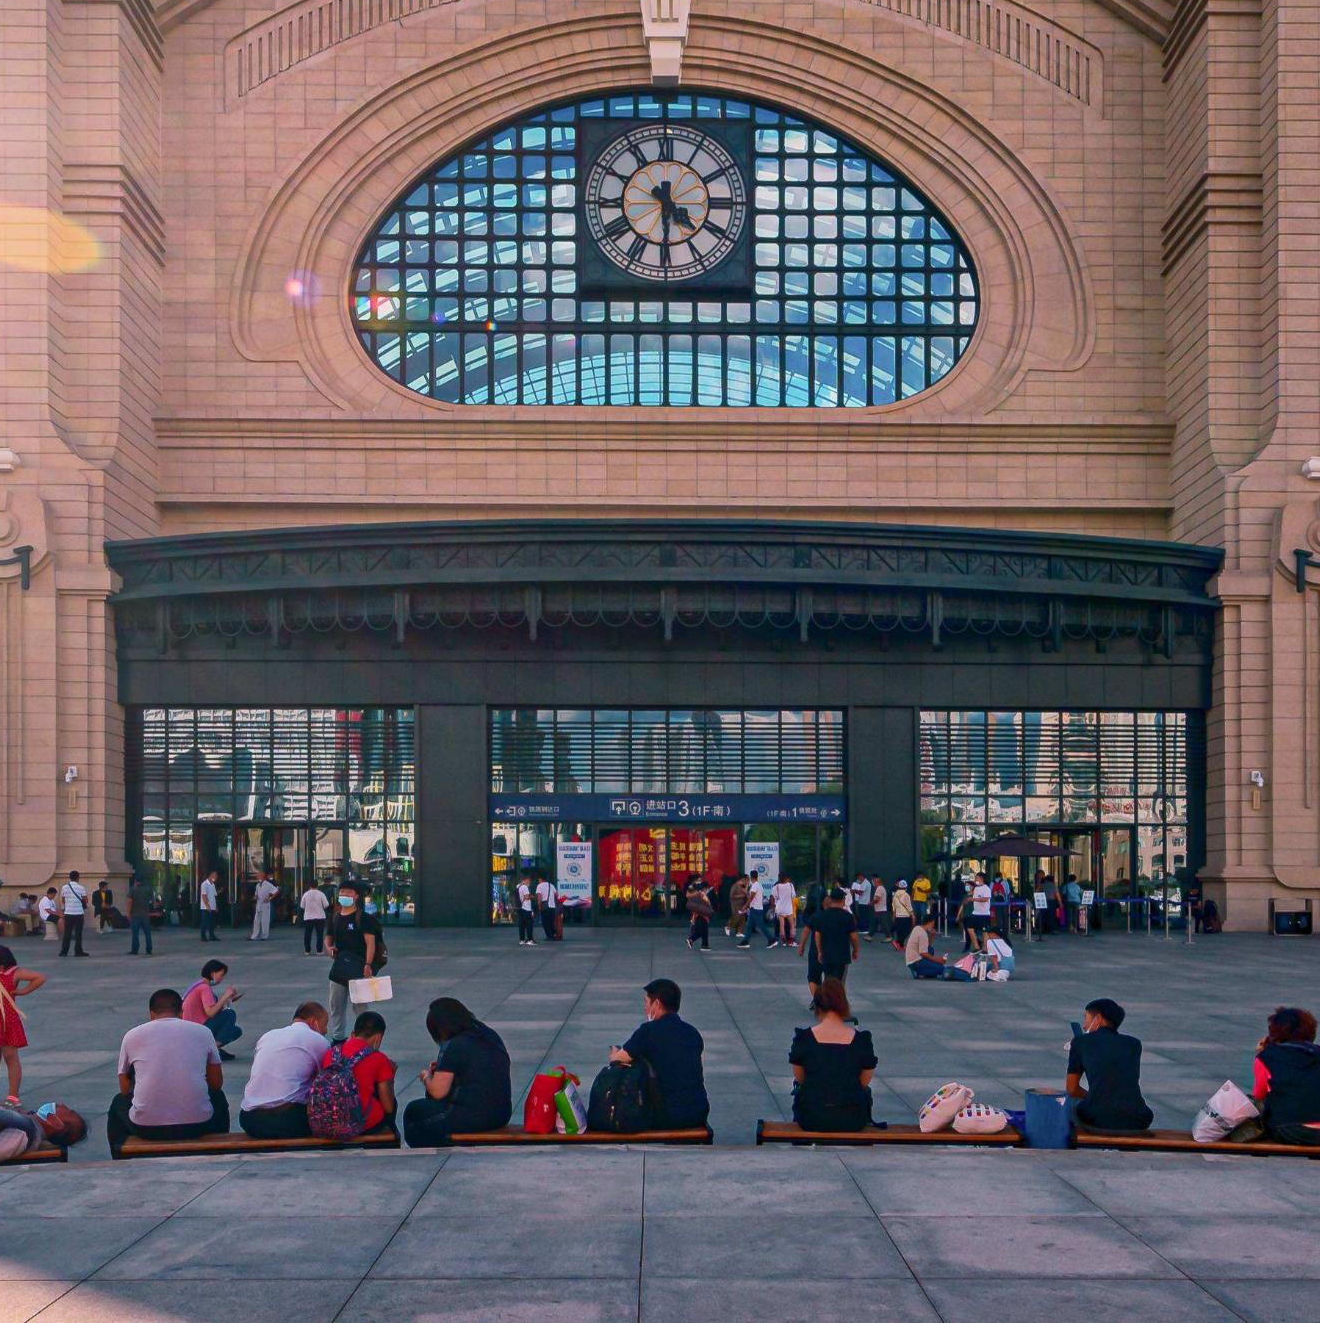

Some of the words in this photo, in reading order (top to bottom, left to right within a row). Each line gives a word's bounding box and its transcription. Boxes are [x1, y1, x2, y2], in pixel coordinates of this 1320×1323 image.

[646, 800, 676, 810] 进站口
[678, 800, 689, 816] 3
